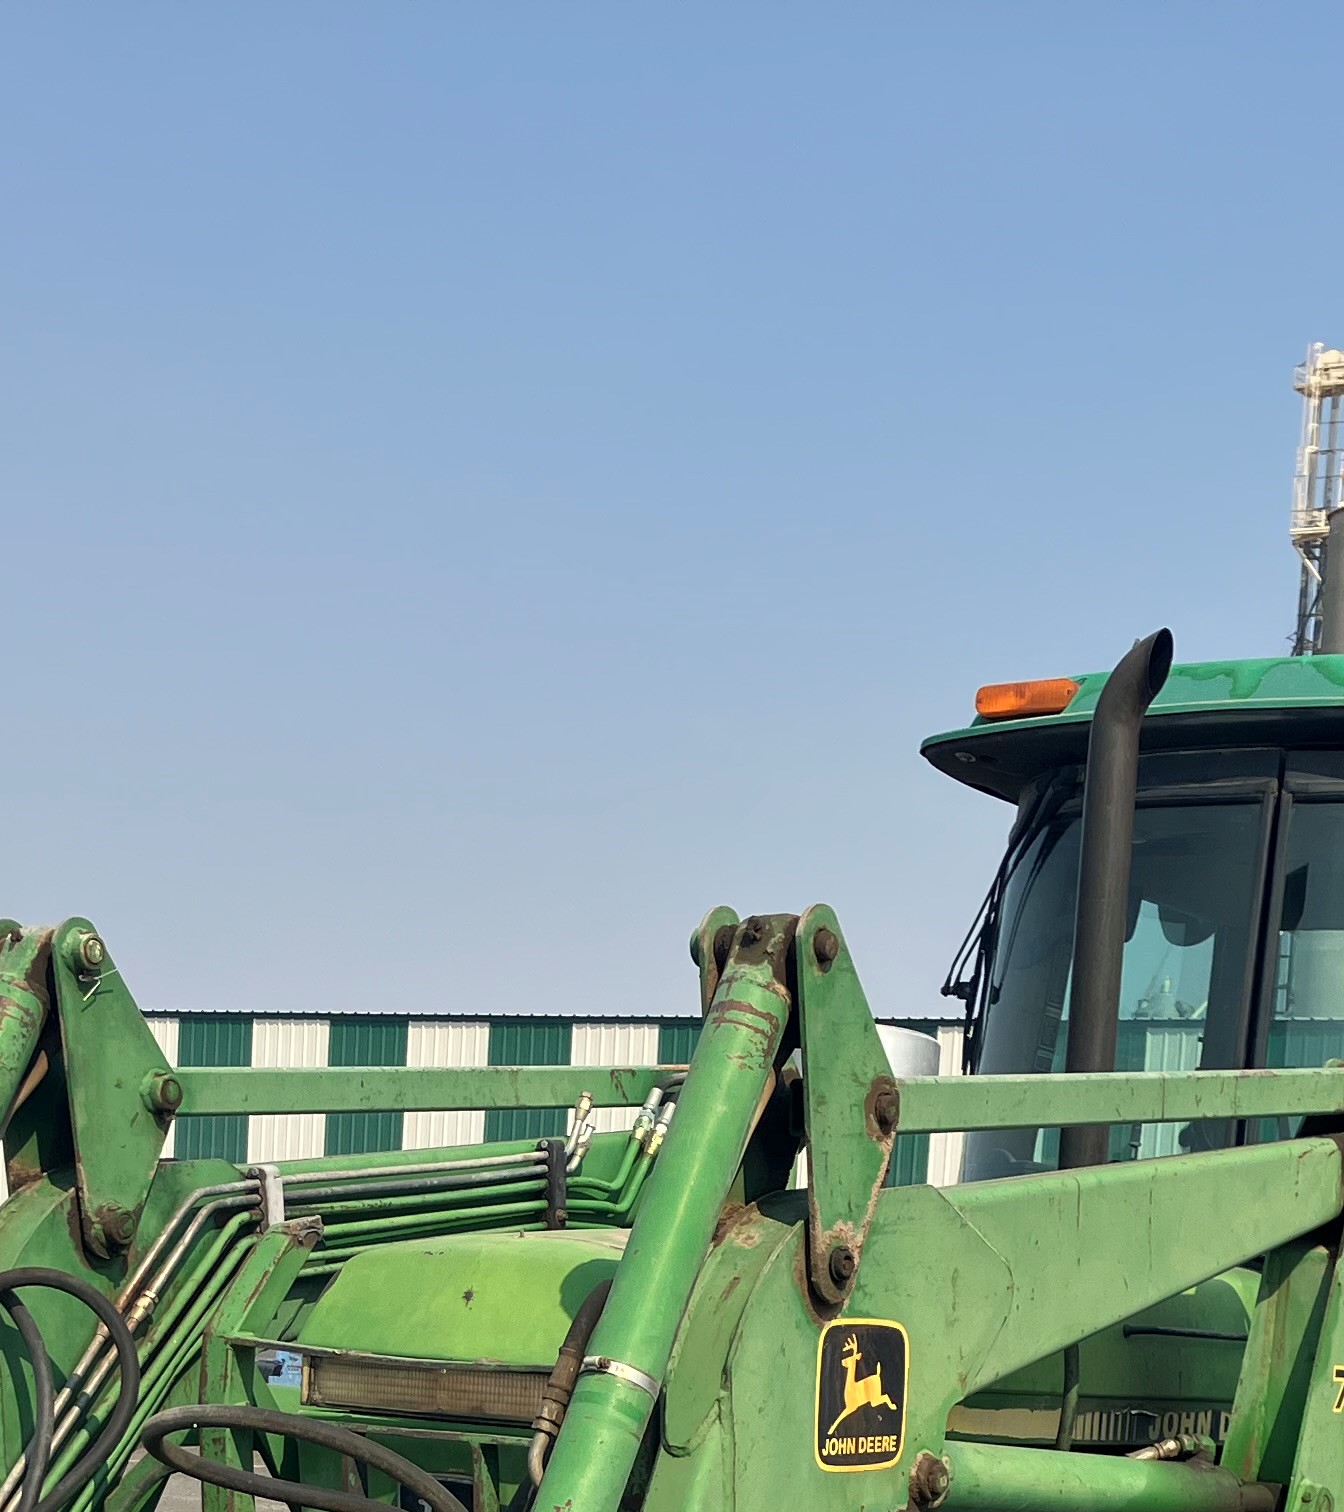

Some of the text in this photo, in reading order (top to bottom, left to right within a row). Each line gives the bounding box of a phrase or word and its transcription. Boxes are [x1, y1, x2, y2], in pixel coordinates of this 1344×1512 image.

[1148, 1410, 1213, 1440] JOHN
[821, 1435, 898, 1456] JOHN DEERE
